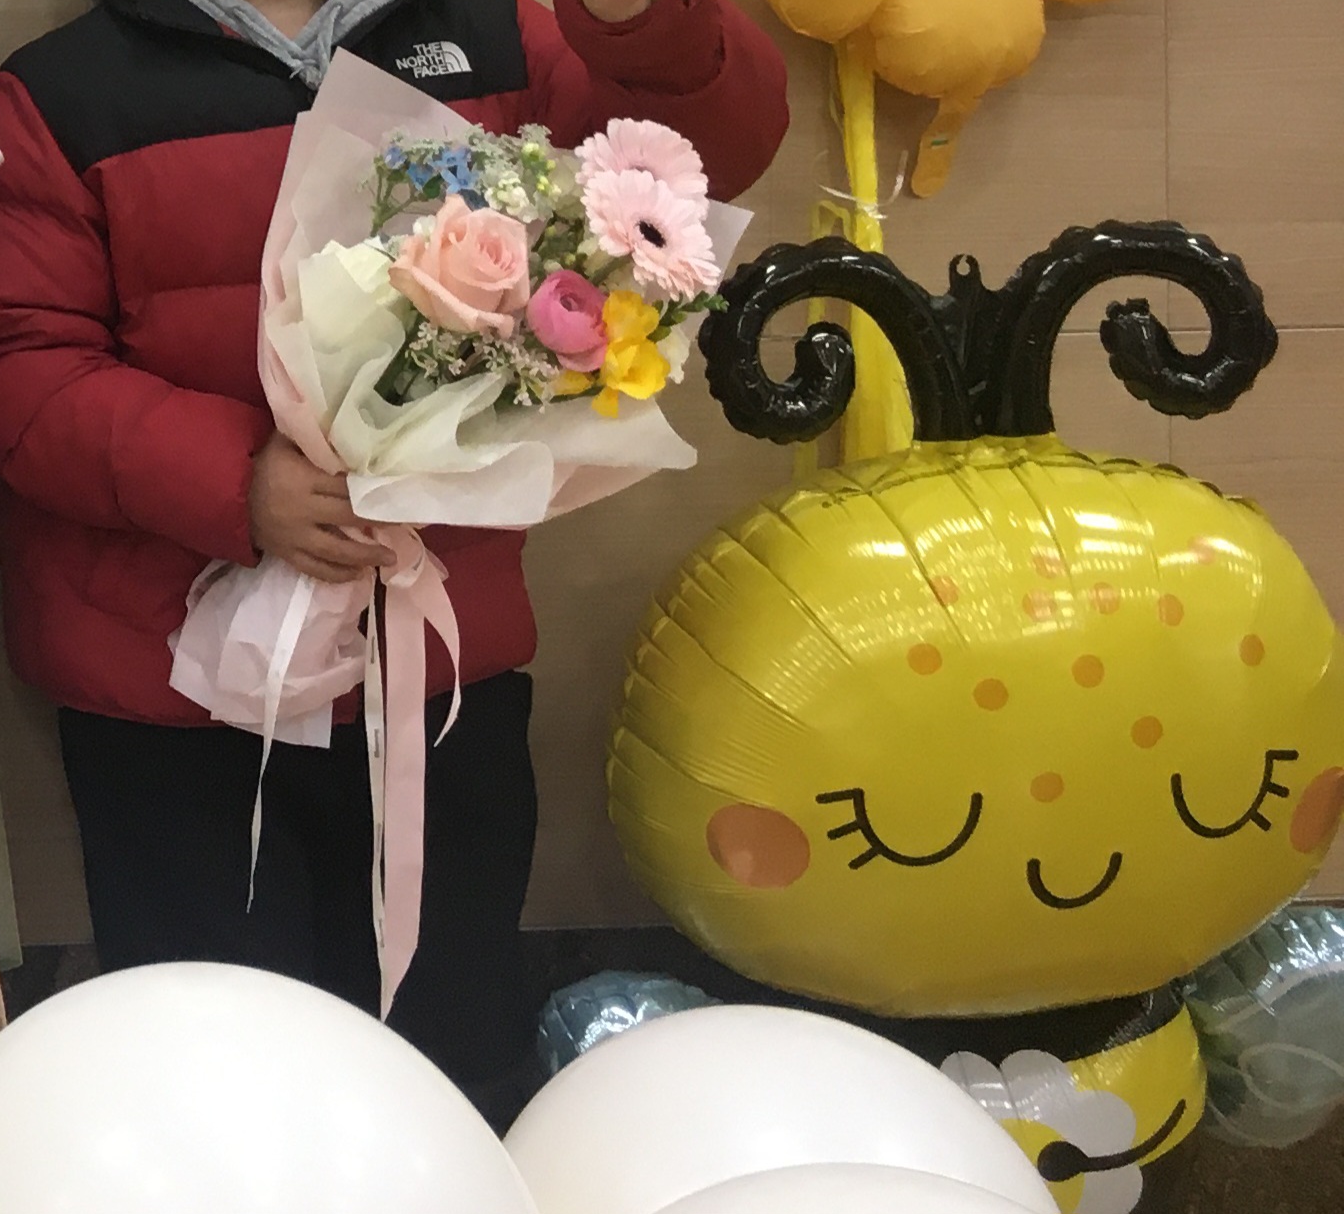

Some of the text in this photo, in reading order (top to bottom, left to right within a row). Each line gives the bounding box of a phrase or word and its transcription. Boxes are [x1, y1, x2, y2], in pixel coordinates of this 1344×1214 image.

[413, 41, 444, 56] THE
[395, 52, 447, 71] NORTH
[413, 65, 448, 79] FACE
